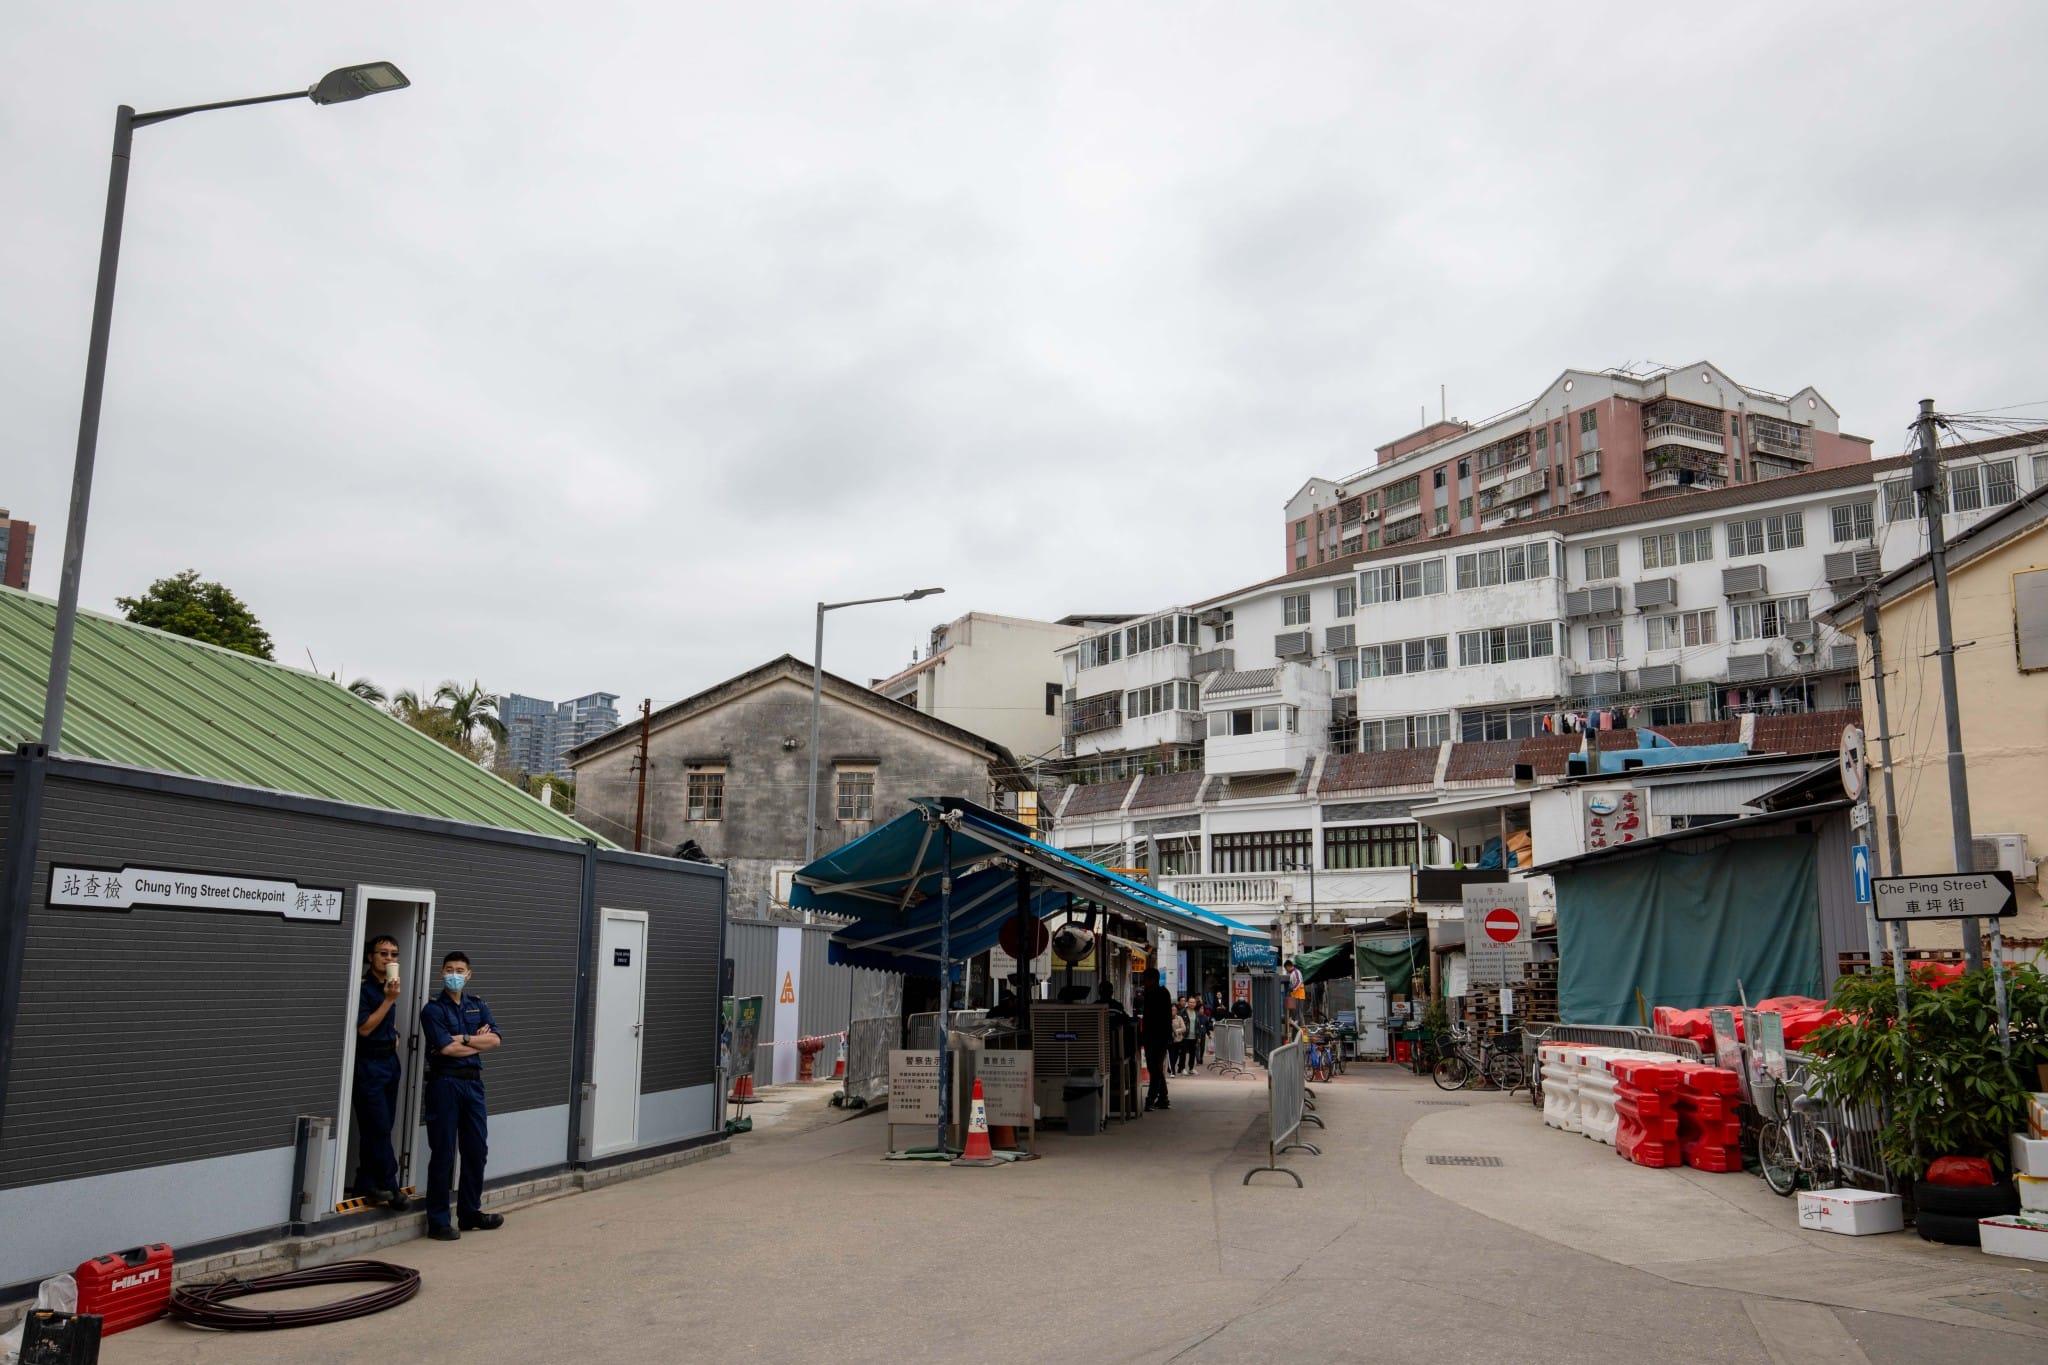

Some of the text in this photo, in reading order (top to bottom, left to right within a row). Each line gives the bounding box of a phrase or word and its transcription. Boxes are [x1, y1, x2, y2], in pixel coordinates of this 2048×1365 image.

[135, 879, 285, 903] Chung Ying Street Checkpoint
[1879, 879, 1987, 894] Che Ping Street
[1906, 898, 1964, 914] 車坪街
[111, 1268, 160, 1291] HILTI
